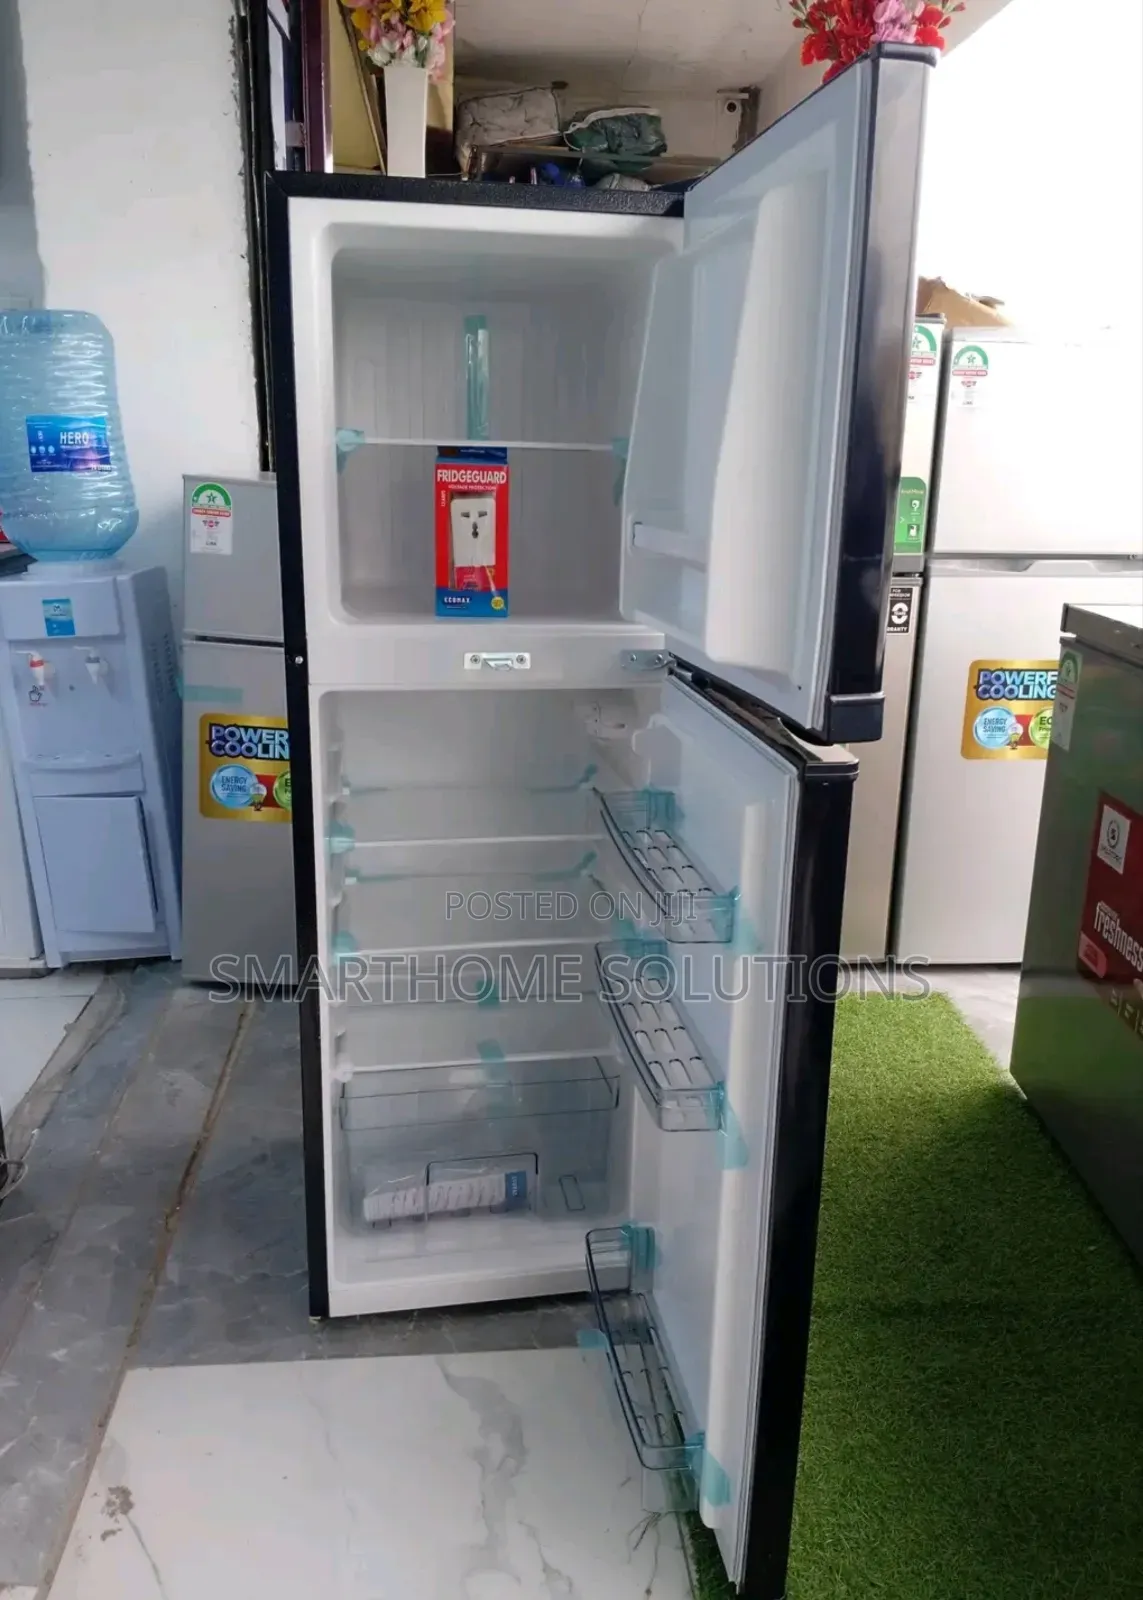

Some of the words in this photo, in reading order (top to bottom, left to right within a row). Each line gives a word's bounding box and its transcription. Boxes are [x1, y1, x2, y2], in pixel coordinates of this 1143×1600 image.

[60, 431, 89, 445] HERO
[437, 469, 507, 485] FRIDGEGUARD
[983, 717, 1008, 726] ENERGY
[982, 725, 1007, 733] SAVING
[221, 776, 247, 785] ENERGY
[221, 784, 247, 793] SAVING
